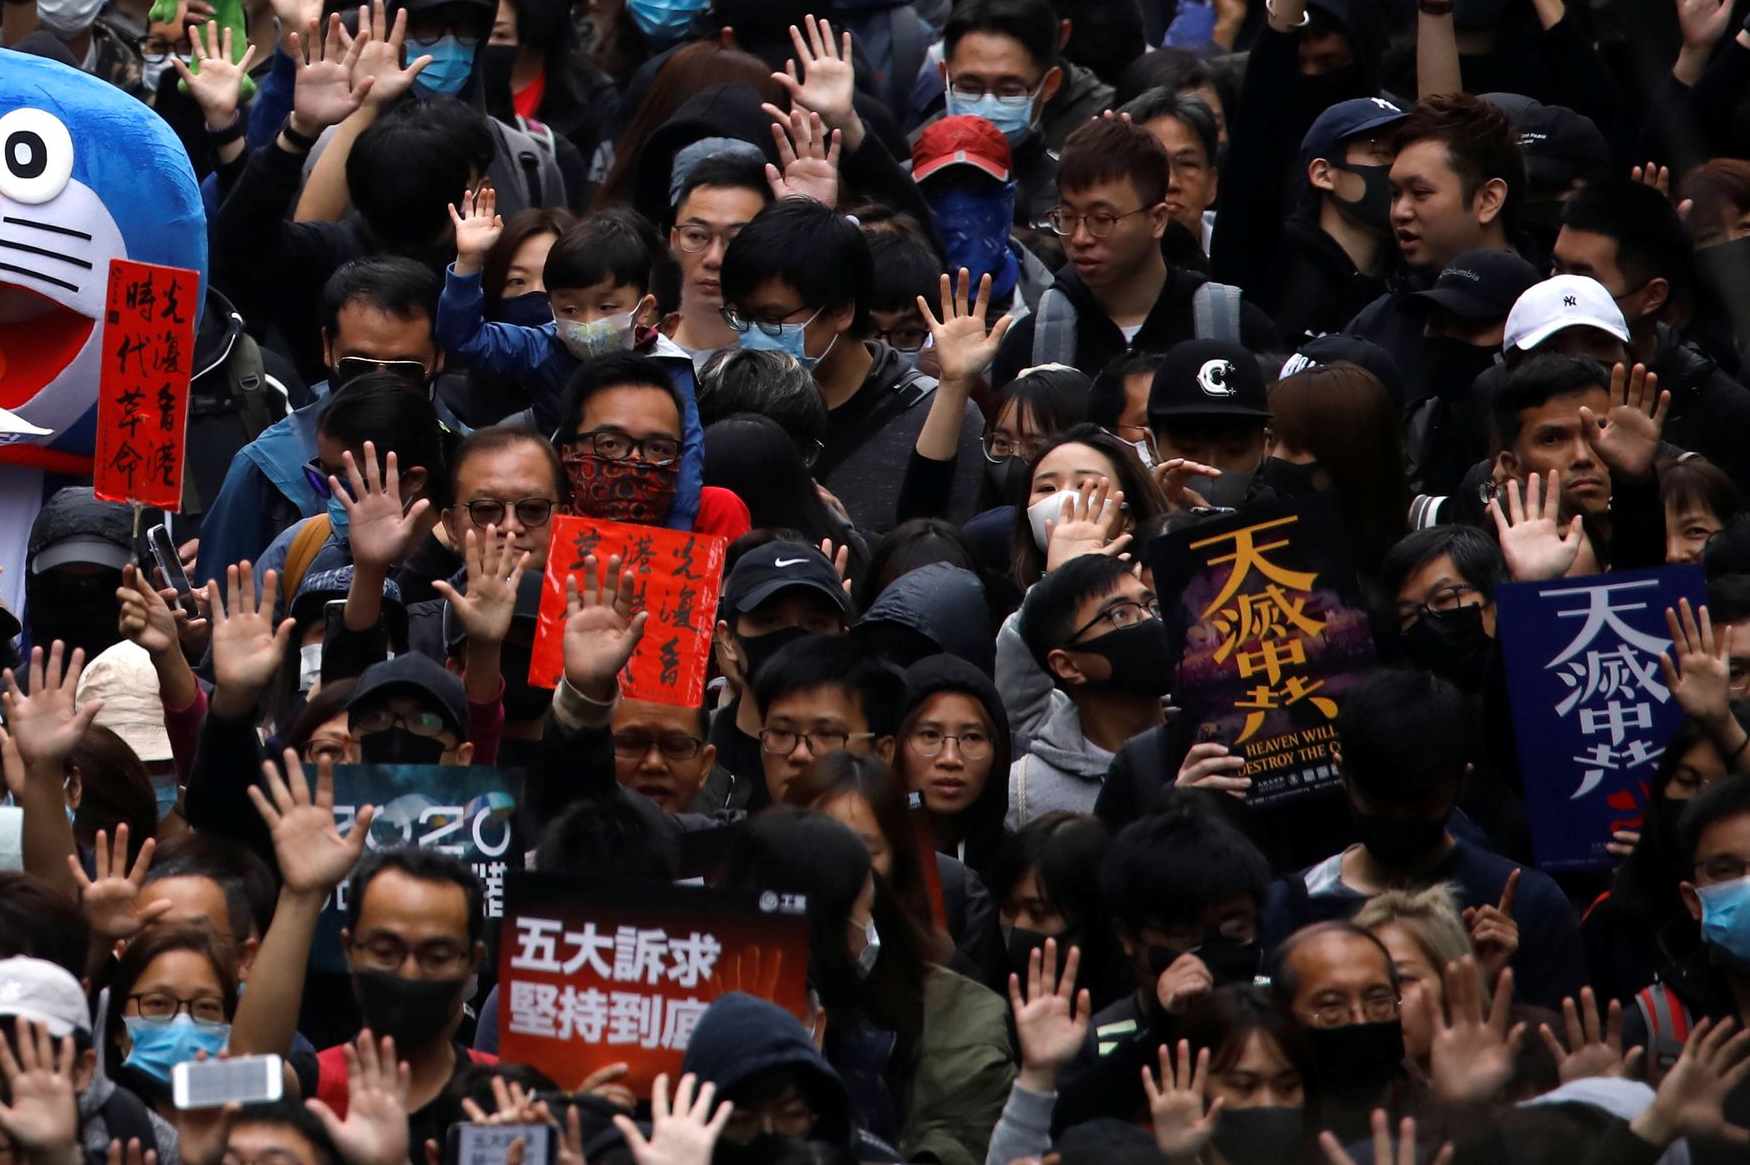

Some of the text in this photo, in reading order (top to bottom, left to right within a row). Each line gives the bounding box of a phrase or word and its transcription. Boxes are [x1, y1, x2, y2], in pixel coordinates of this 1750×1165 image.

[1190, 515, 1340, 746] 天滅中共
[1538, 578, 1676, 800] 天滅中共
[1246, 724, 1339, 757] HEAVEN WILL
[1298, 744, 1327, 762] THE
[510, 915, 722, 989] 五大訴求
